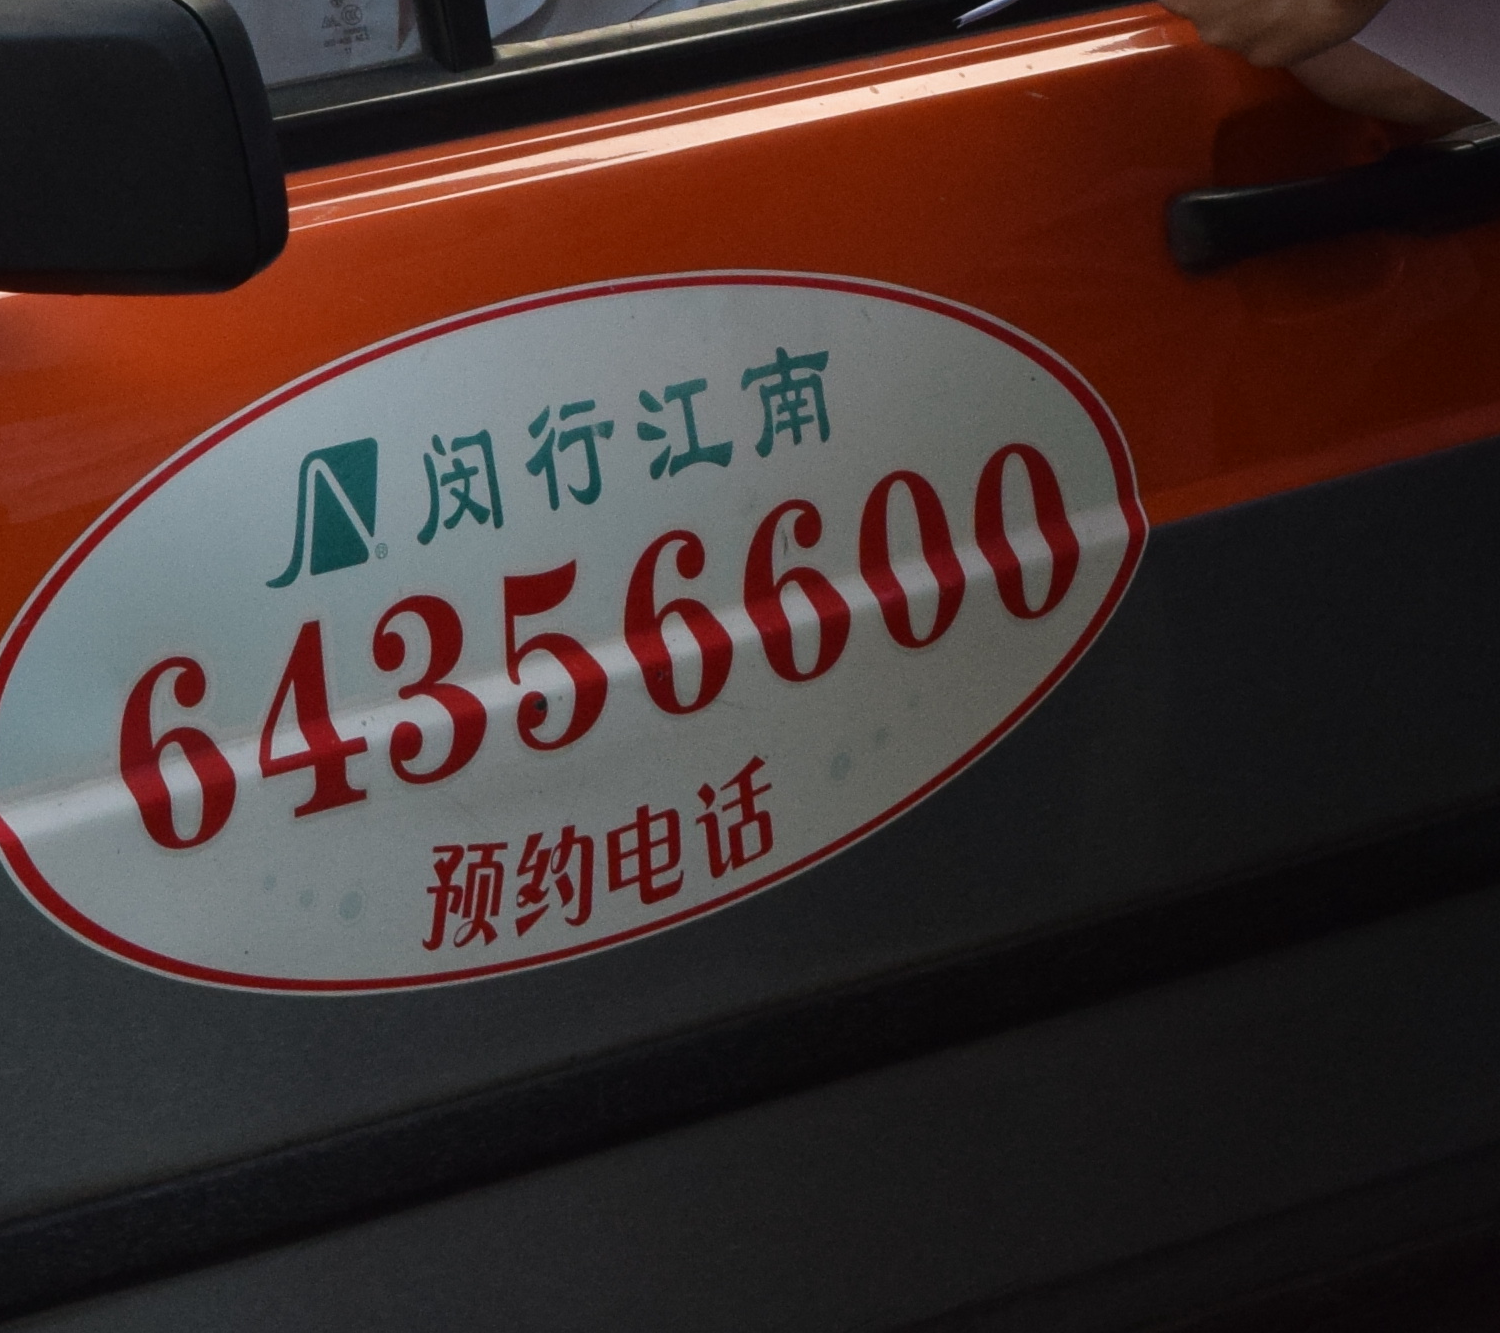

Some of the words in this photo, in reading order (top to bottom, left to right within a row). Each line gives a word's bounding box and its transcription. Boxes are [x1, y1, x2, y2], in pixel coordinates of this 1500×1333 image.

[415, 346, 831, 546] 闵行江南
[116, 442, 1082, 852] 64356600
[420, 755, 776, 952] 预约电话
